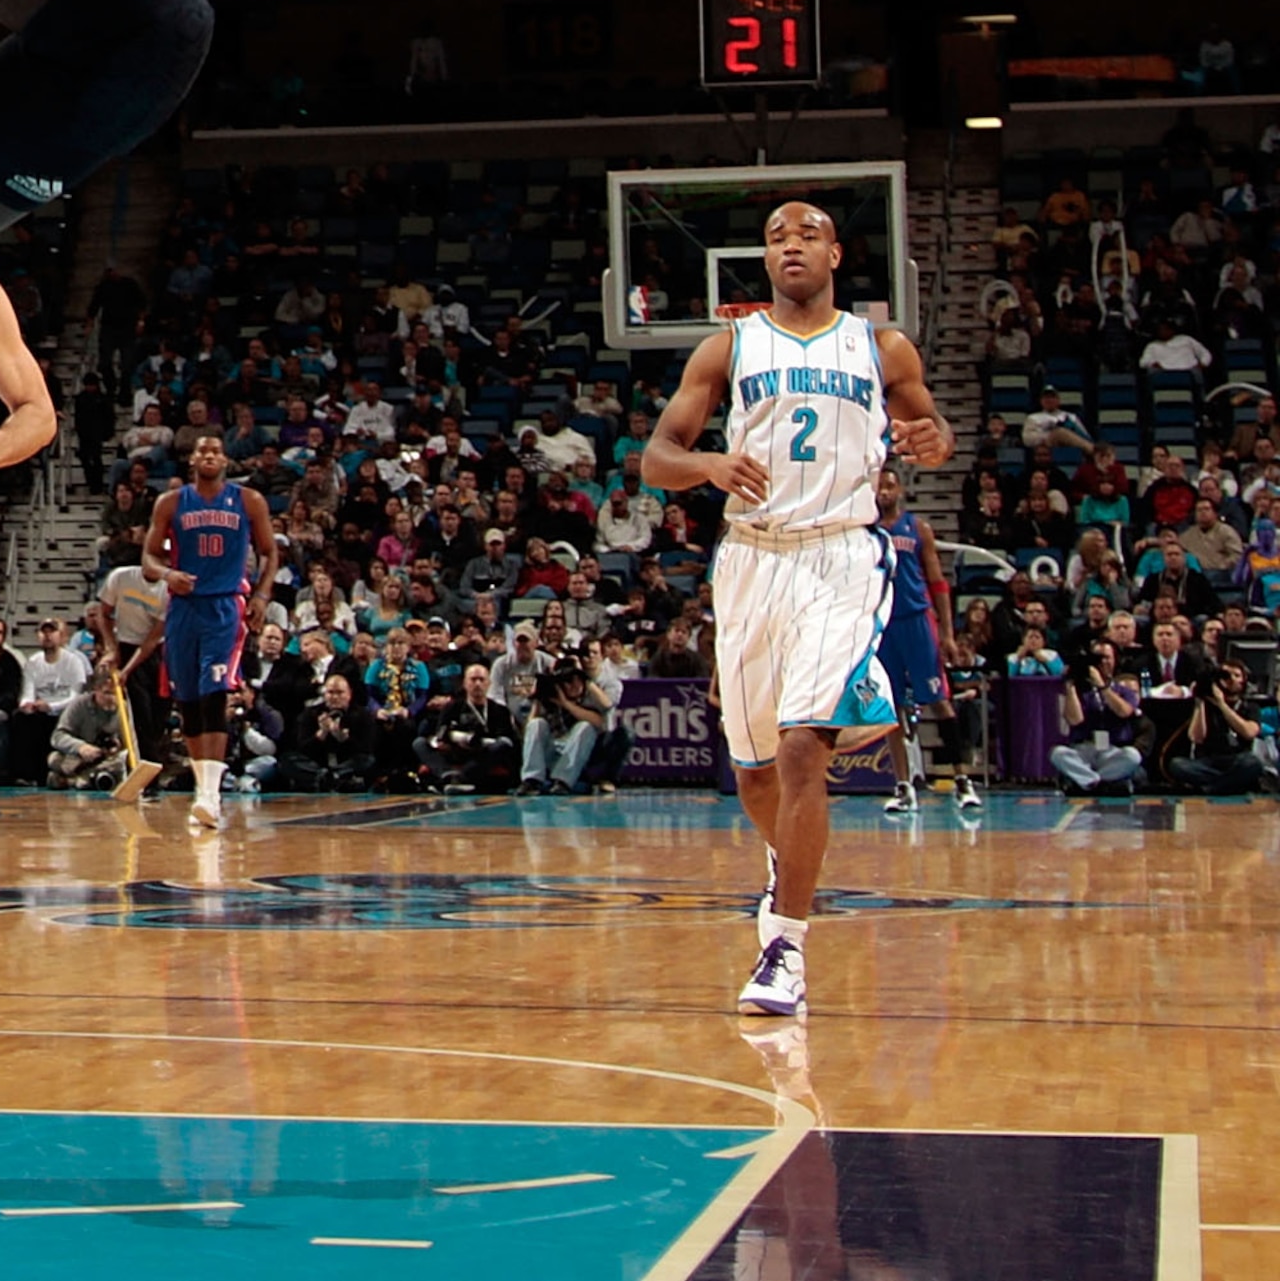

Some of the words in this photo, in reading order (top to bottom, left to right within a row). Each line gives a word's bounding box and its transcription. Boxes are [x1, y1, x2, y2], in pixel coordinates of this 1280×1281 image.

[723, 16, 800, 75] 21
[738, 368, 781, 413] NEW
[786, 366, 875, 413] ORLEANS
[789, 405, 820, 462] 2
[197, 532, 225, 557] 10
[624, 746, 713, 767] OLLERS
